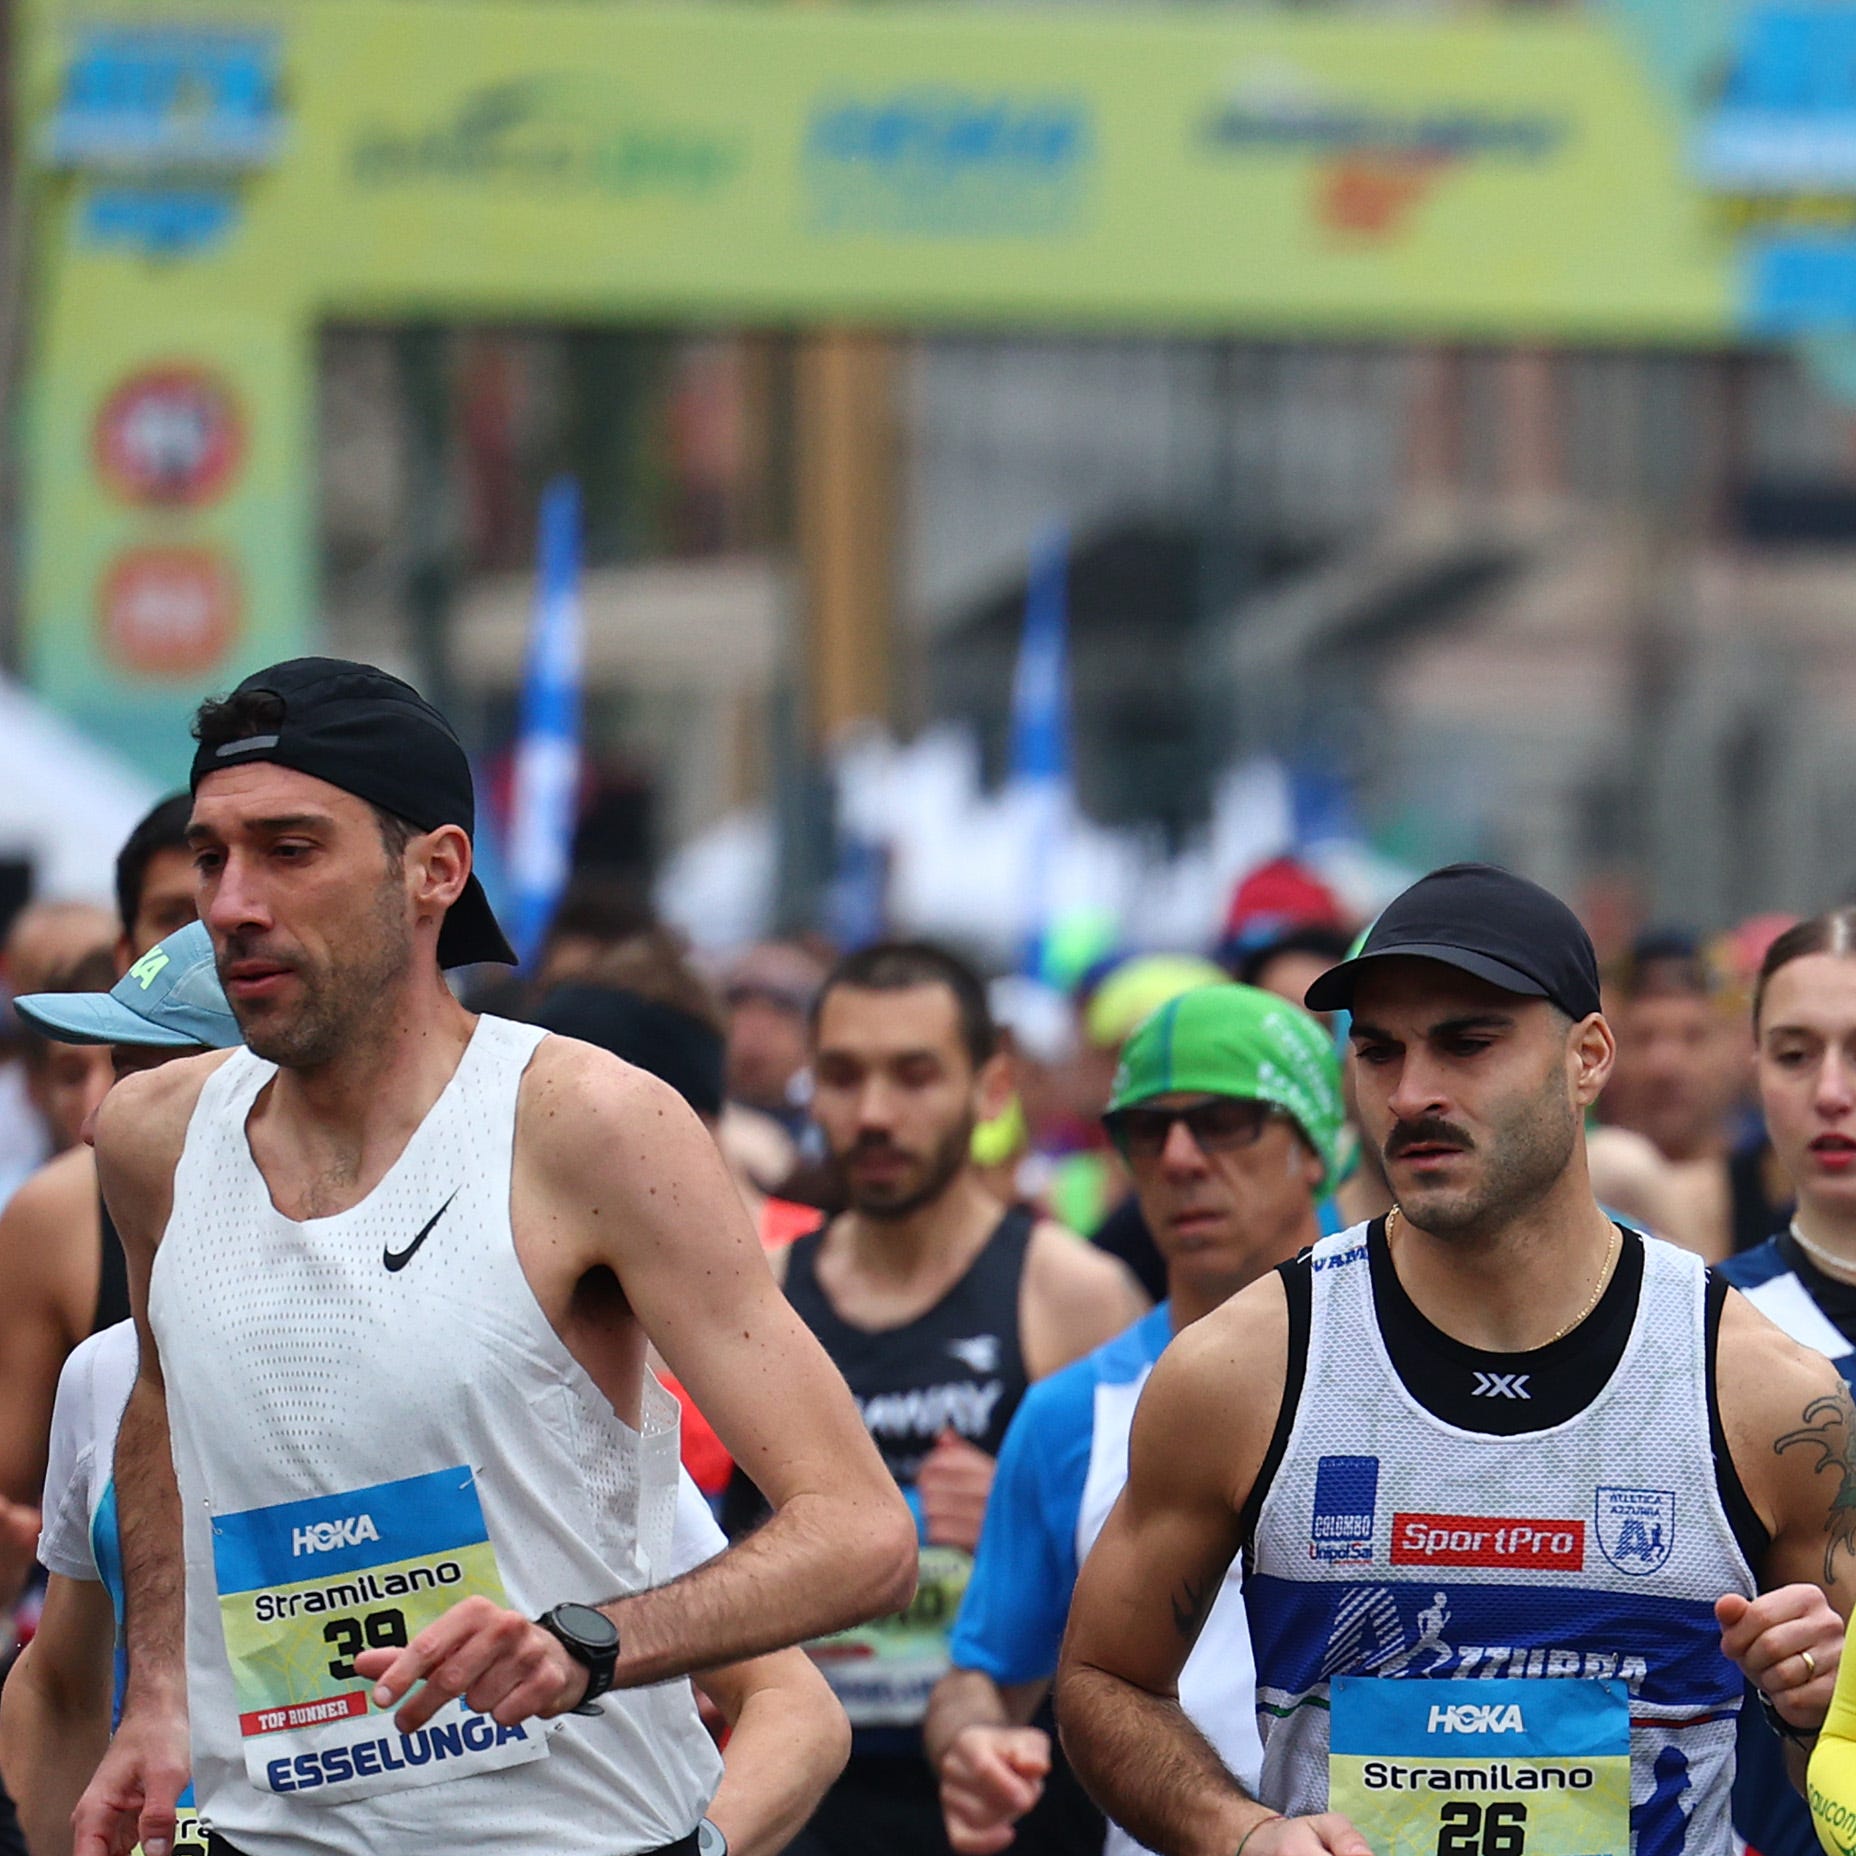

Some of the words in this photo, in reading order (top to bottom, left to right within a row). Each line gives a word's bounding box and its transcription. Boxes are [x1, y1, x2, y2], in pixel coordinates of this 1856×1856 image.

[292, 1514, 381, 1557] HOKA
[1314, 1515, 1371, 1537] COLOMBO
[1402, 1523, 1575, 1555] SportPro
[254, 1561, 463, 1623] Stramilano
[258, 1713, 287, 1731] TOP
[289, 1700, 349, 1726] RUNNER
[1426, 1704, 1525, 1734] HOKA
[266, 1716, 529, 1794] ESSELUNGA
[1364, 1761, 1595, 1790] Stramilano
